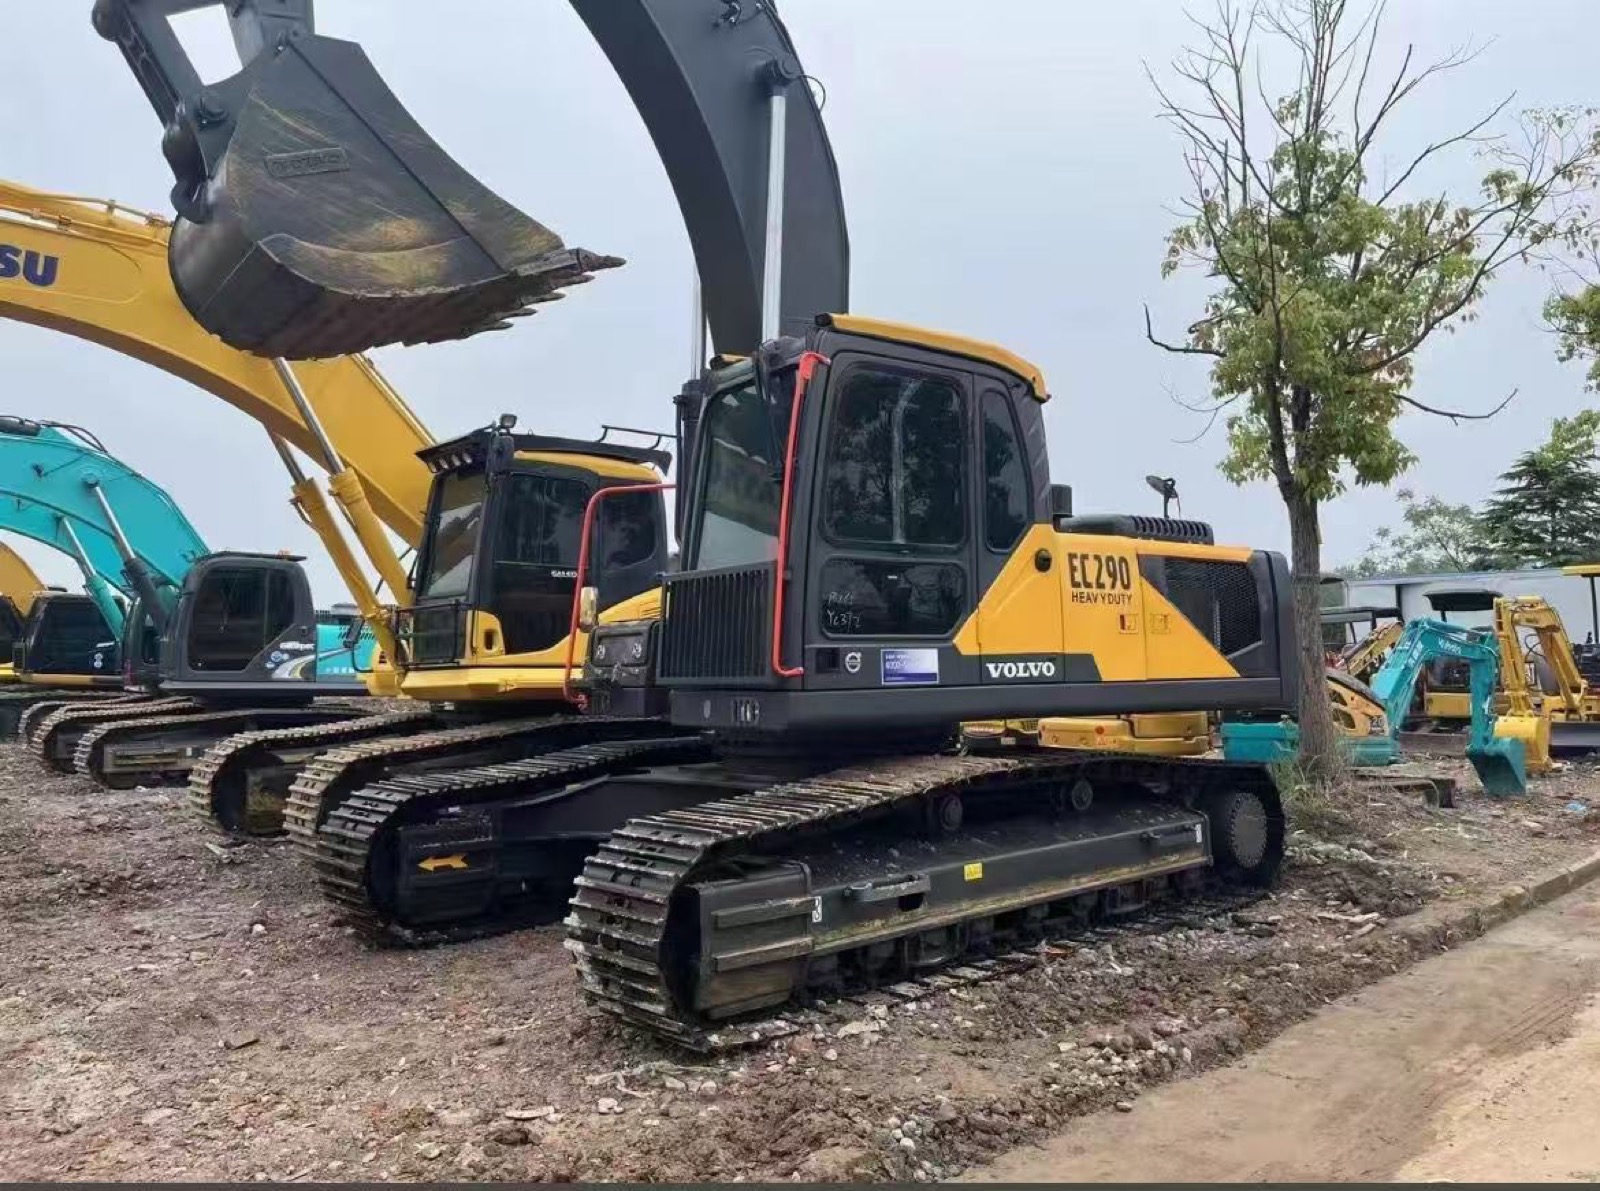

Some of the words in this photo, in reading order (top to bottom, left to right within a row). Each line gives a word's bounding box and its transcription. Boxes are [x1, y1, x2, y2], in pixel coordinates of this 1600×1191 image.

[0, 244, 59, 287] SU
[1067, 552, 1131, 590] EC290
[985, 661, 1055, 678] VOLVO
